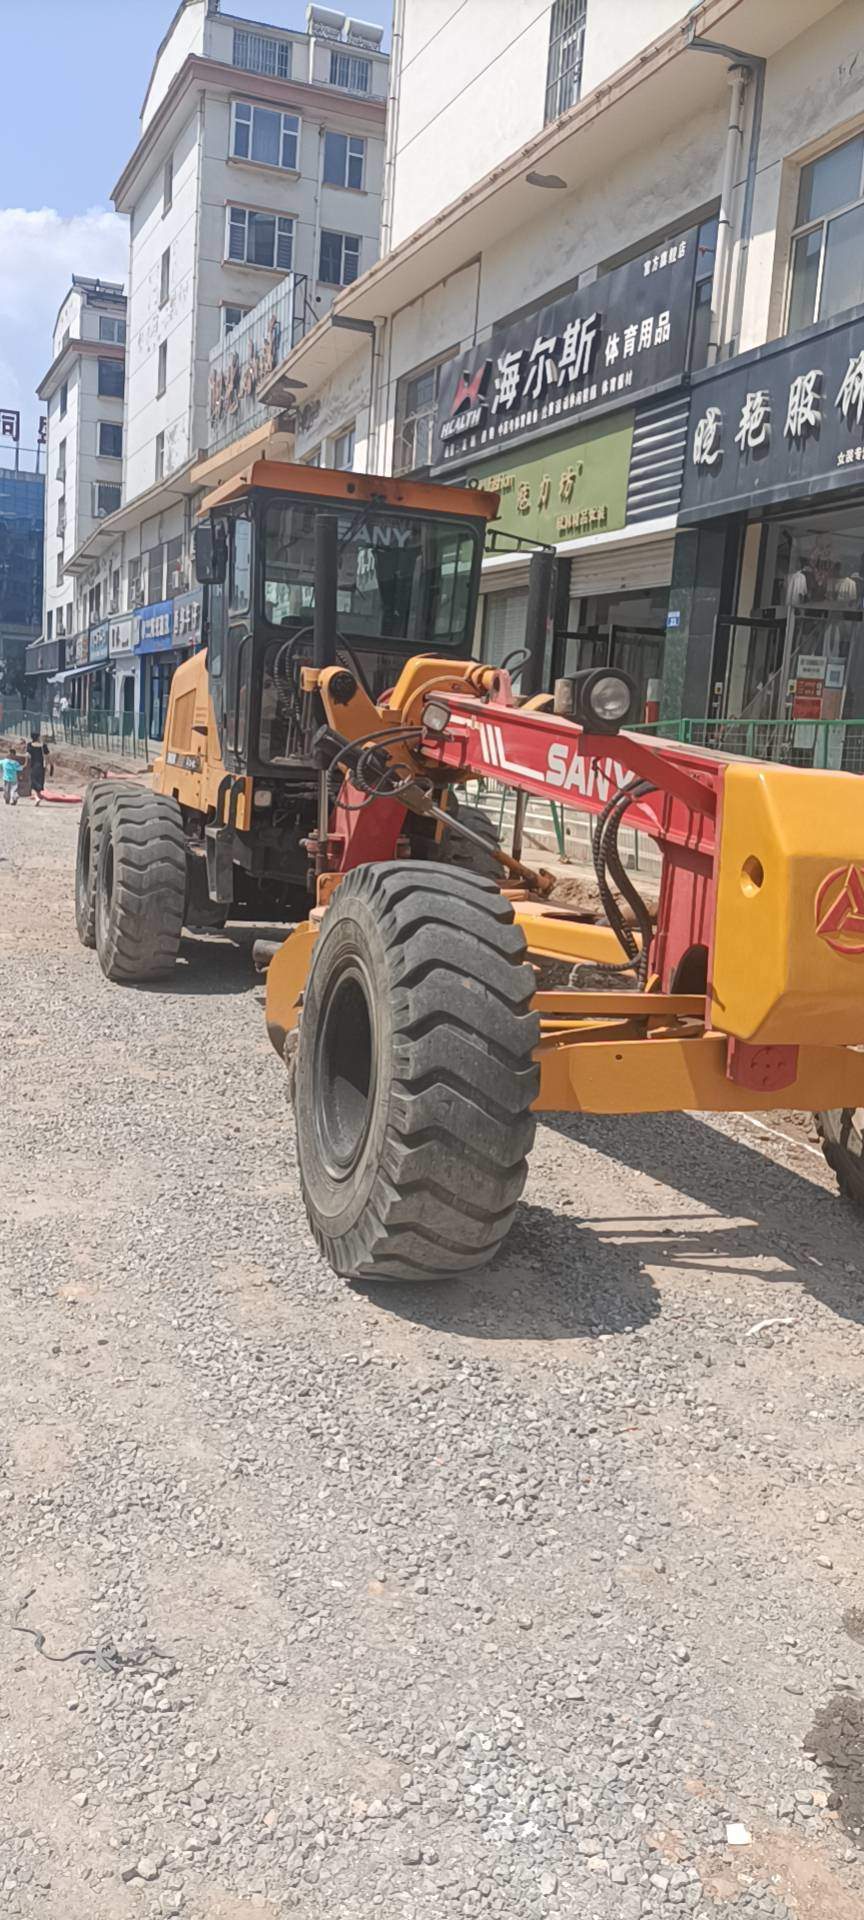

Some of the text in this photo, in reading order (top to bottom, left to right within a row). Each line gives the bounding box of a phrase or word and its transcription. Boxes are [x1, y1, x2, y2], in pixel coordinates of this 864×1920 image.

[491, 310, 671, 414] 海尔斯 体育用品
[441, 407, 482, 438] HEALTH
[837, 446, 864, 466] 女装专
[545, 743, 636, 802] SANY
